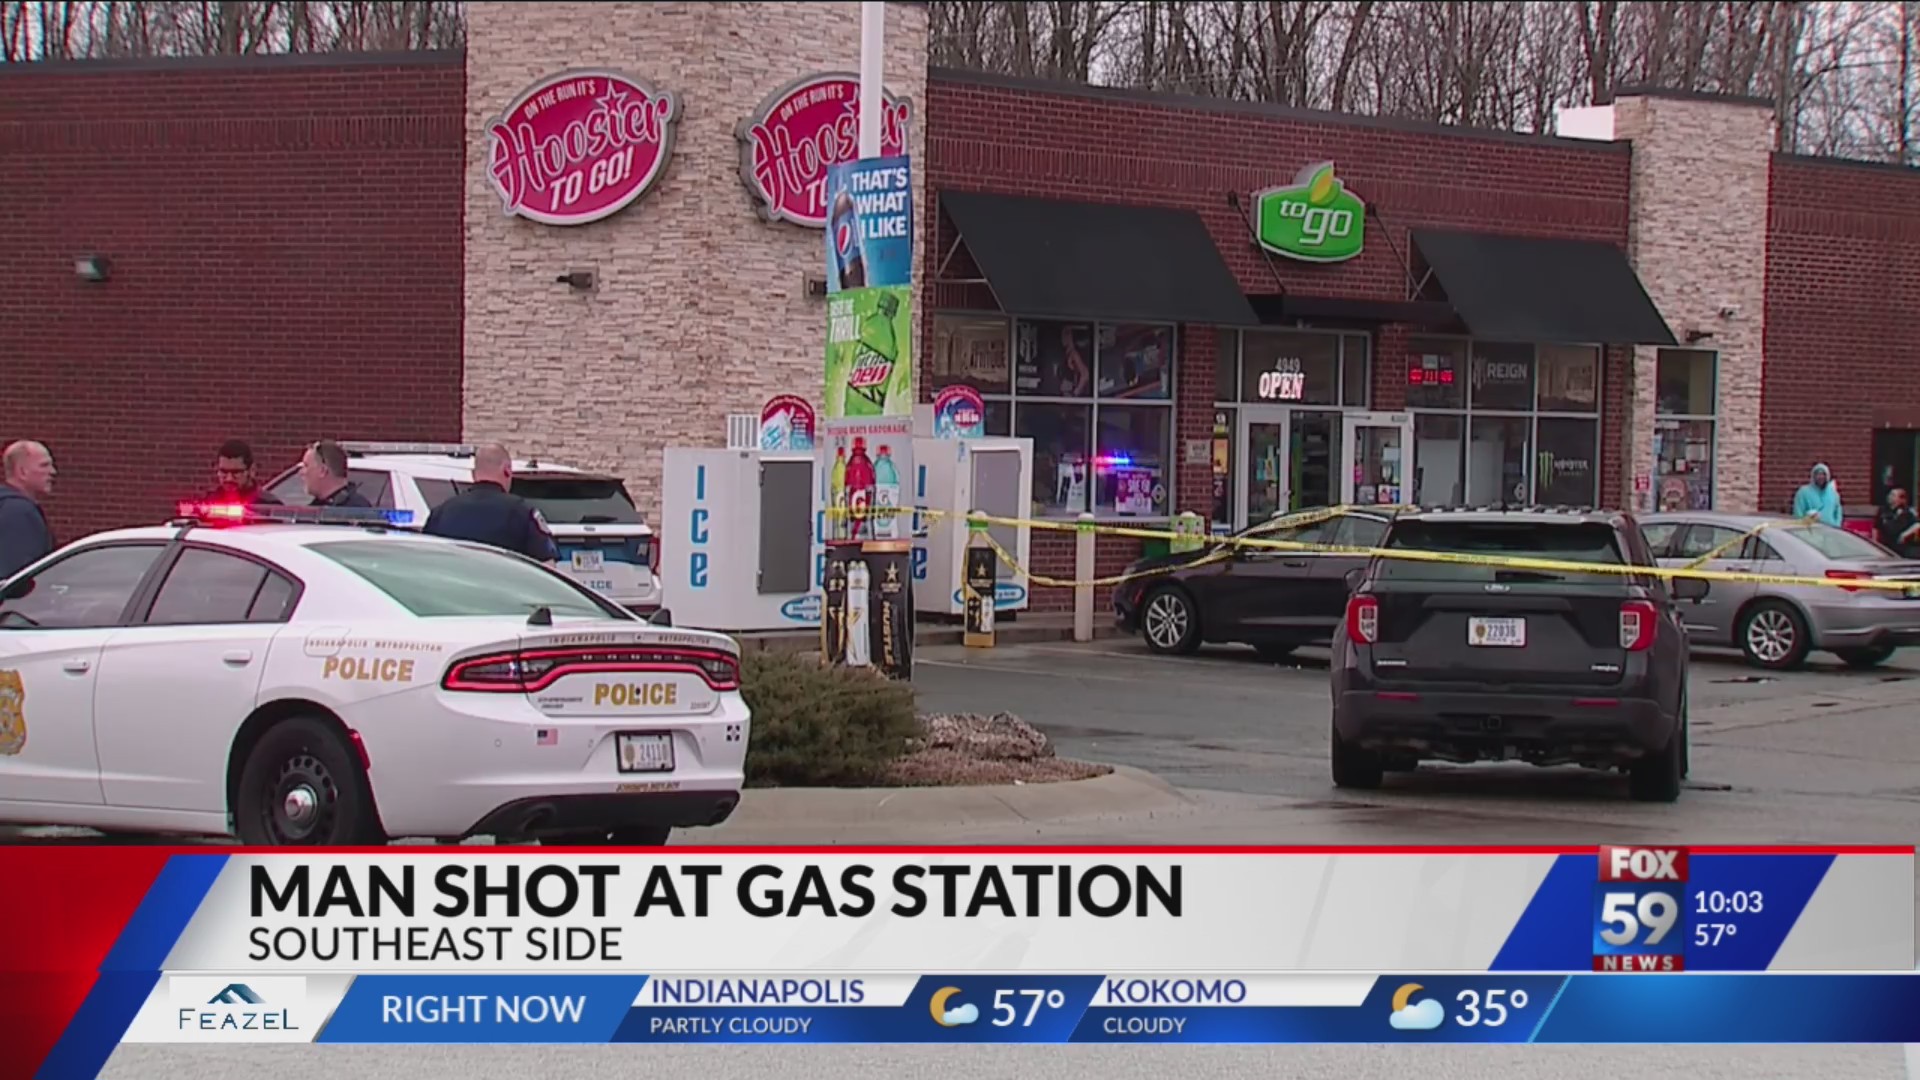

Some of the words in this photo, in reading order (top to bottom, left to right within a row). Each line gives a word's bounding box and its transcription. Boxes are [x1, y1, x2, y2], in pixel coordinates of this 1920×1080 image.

[538, 89, 556, 111] THE
[557, 83, 577, 102] RUN
[489, 97, 671, 210] Hoosier
[750, 104, 909, 215] Hoosr
[550, 170, 584, 211] TO
[589, 146, 634, 194] GO!
[852, 167, 907, 192] THAT'S
[857, 191, 907, 215] WHAT
[869, 215, 907, 239] LIKE
[1487, 362, 1528, 379] REIGN
[1258, 372, 1304, 400] OPEN
[323, 656, 415, 682] POLICE
[594, 683, 677, 706] POLICE
